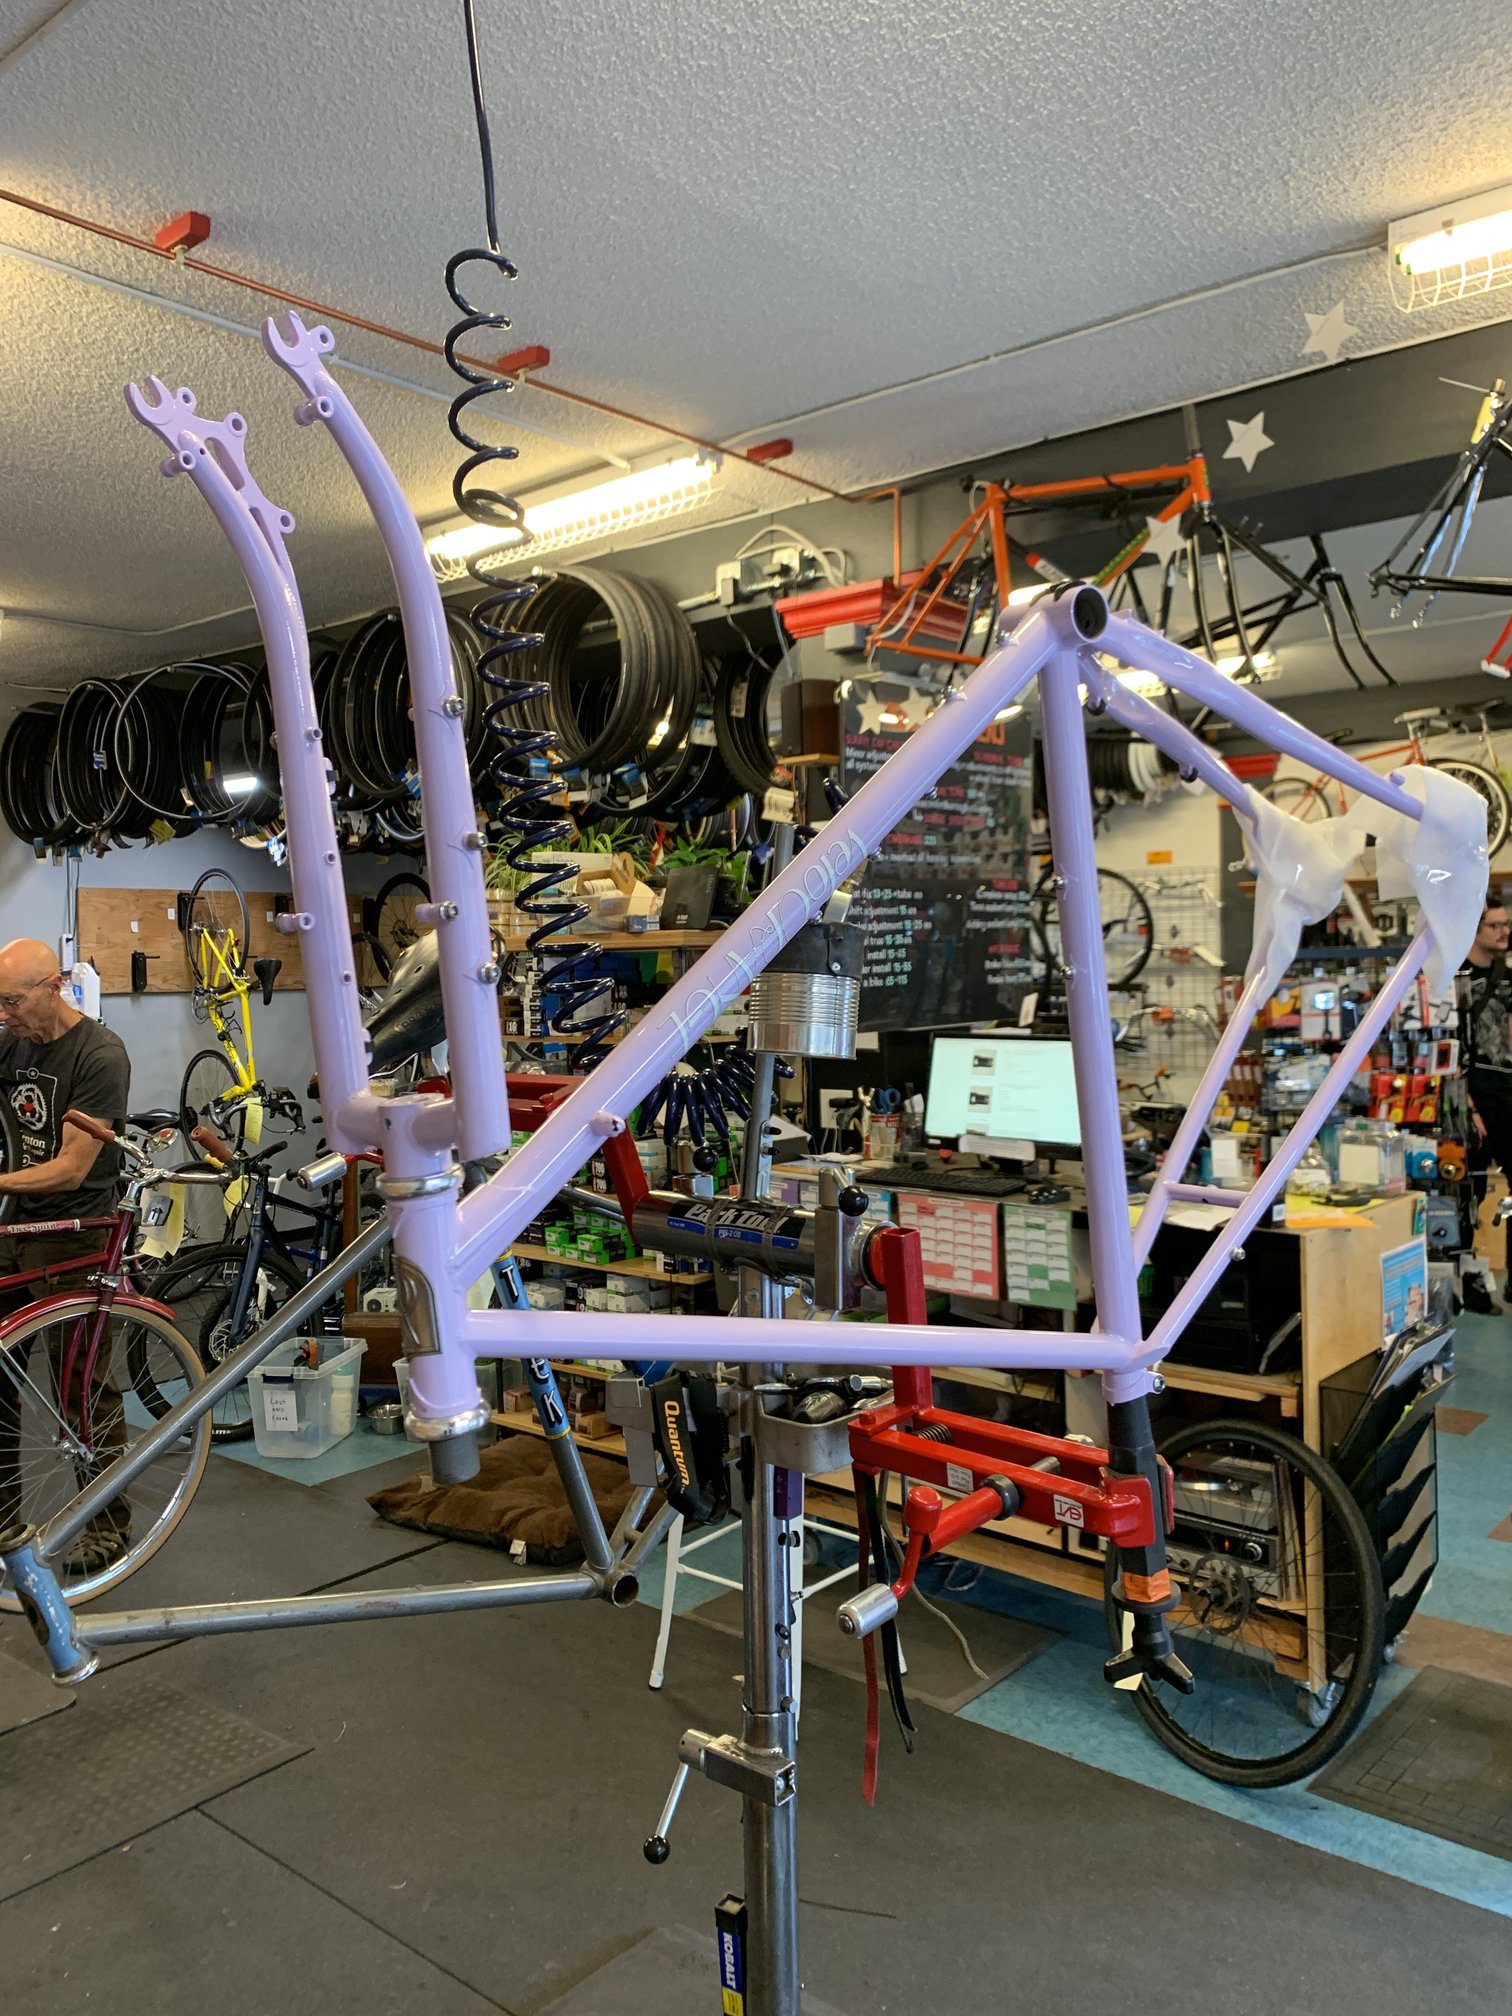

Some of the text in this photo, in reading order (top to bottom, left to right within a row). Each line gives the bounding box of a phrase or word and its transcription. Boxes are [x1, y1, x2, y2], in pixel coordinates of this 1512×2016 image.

[684, 1203, 741, 1225] Pak
[664, 1400, 690, 1486] Quantum
[723, 1931, 737, 1990] KOBALT
